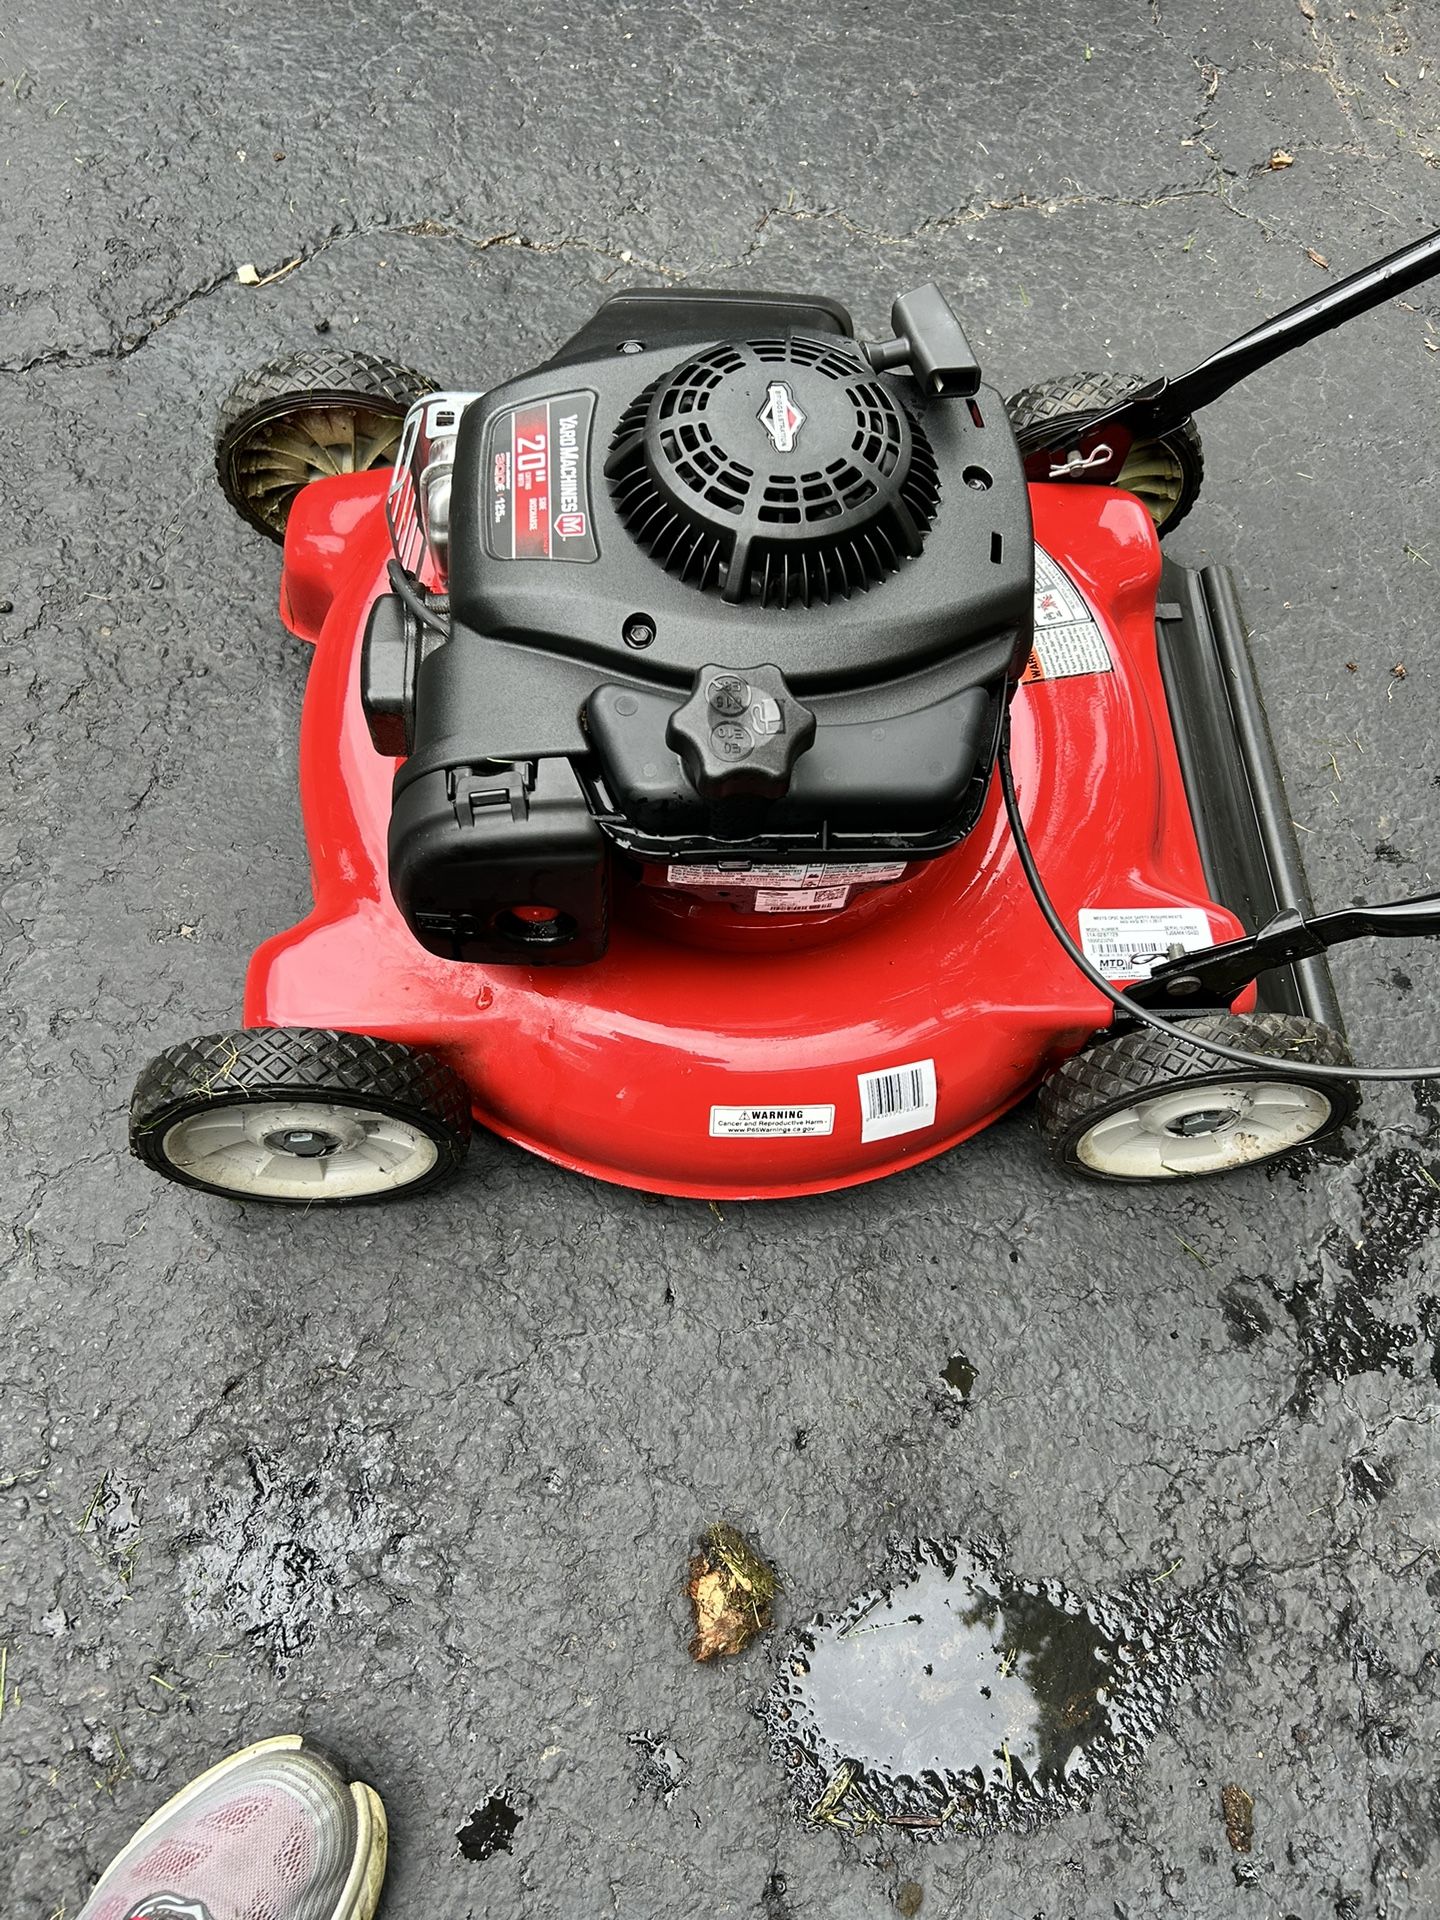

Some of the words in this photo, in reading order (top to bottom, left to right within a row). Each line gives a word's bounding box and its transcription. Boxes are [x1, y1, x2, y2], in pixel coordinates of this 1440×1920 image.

[517, 434, 547, 482] 20"
[1099, 959, 1124, 967] MTD
[751, 1110, 804, 1120] WARNING
[759, 1119, 804, 1127] Reproductive
